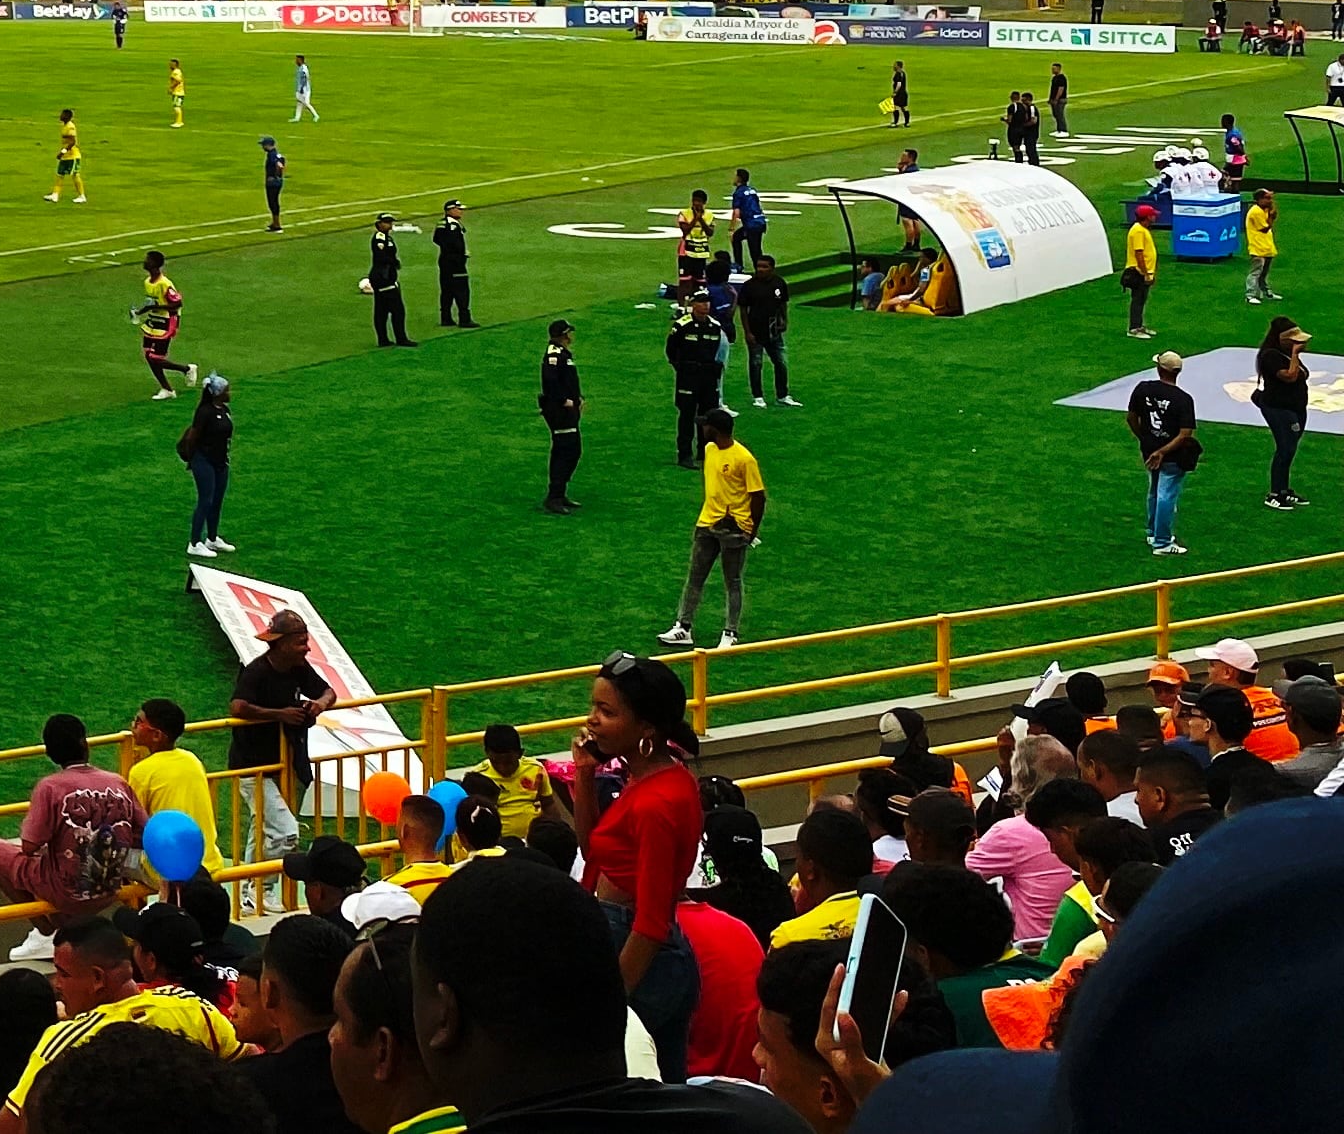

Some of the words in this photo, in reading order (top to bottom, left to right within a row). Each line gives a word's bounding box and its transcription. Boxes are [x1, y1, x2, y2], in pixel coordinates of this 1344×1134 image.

[33, 3, 92, 20] BetPlay
[150, 5, 196, 17] SITTCA
[334, 6, 390, 23] Dotta
[451, 10, 537, 24] CONGESTEX
[744, 18, 784, 31] Mayor
[785, 19, 799, 29] de
[685, 30, 748, 42] Cartagena
[750, 31, 765, 41] de
[996, 27, 1064, 44] SITTCA
[1098, 31, 1168, 46] SITTCA
